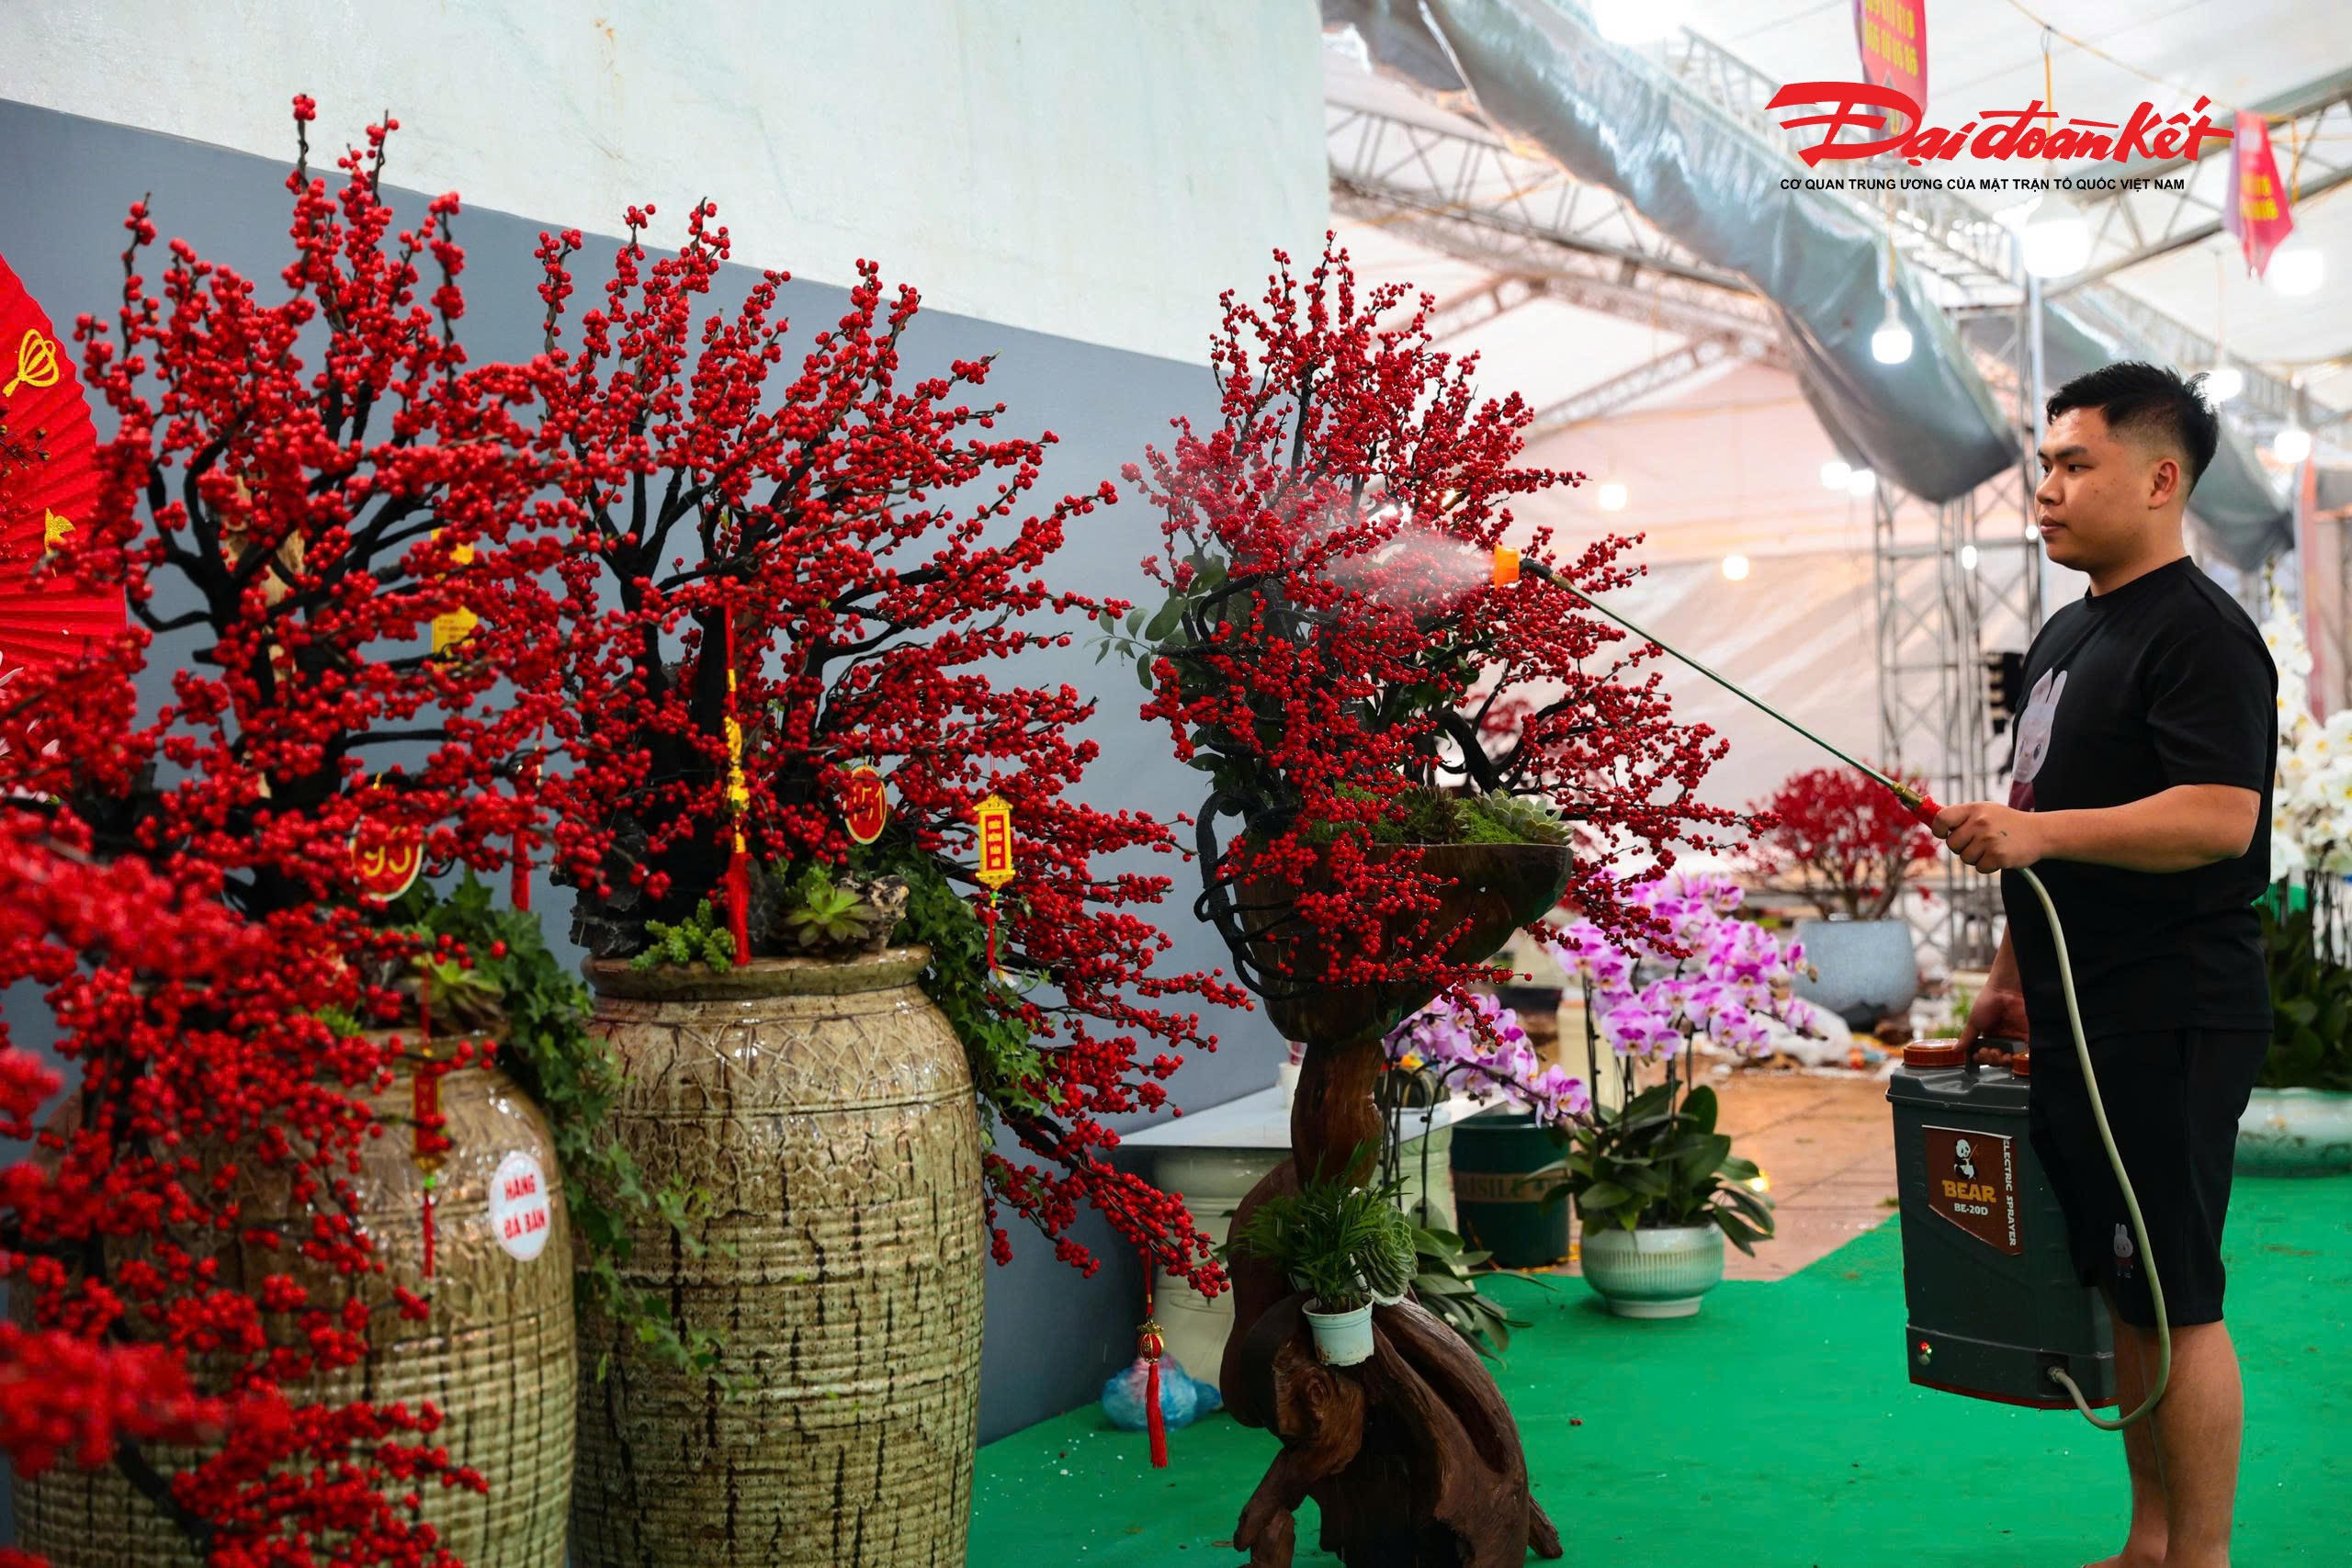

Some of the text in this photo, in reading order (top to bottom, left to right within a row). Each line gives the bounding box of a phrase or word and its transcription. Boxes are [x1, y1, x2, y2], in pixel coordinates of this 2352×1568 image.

[1942, 1179, 1996, 1203] BEAR
[2004, 1139, 2017, 1247] ELECTRIC SPRAYER
[1954, 1202, 1988, 1216] BE-20D
